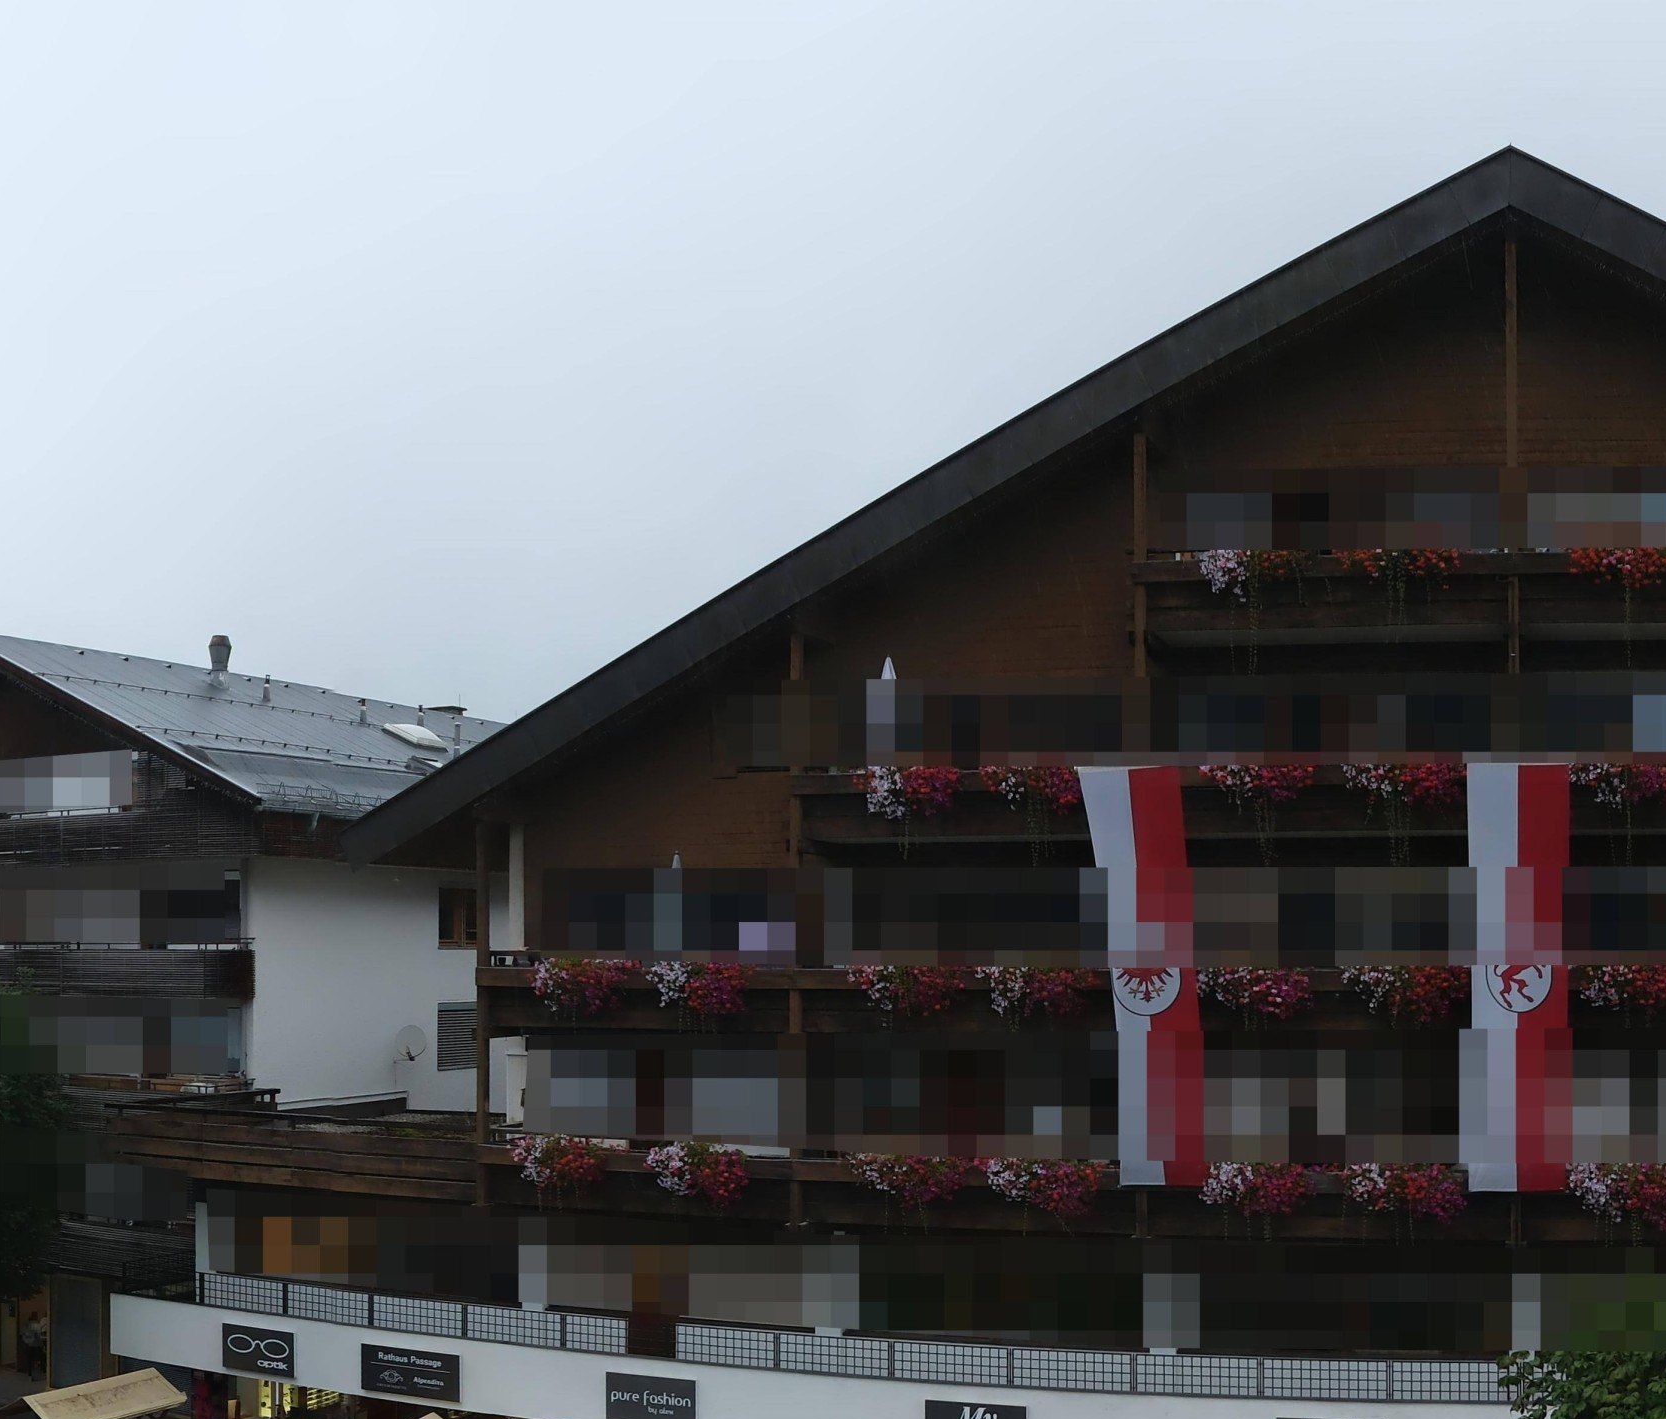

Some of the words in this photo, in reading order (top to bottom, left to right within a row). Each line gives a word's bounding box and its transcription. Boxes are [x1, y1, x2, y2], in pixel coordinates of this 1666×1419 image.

[256, 1359, 289, 1371] optik
[378, 1352, 408, 1363] Rathaus
[410, 1356, 442, 1368] Passage
[611, 1390, 639, 1403] pure
[643, 1391, 691, 1408] fashion
[648, 1406, 657, 1415] by
